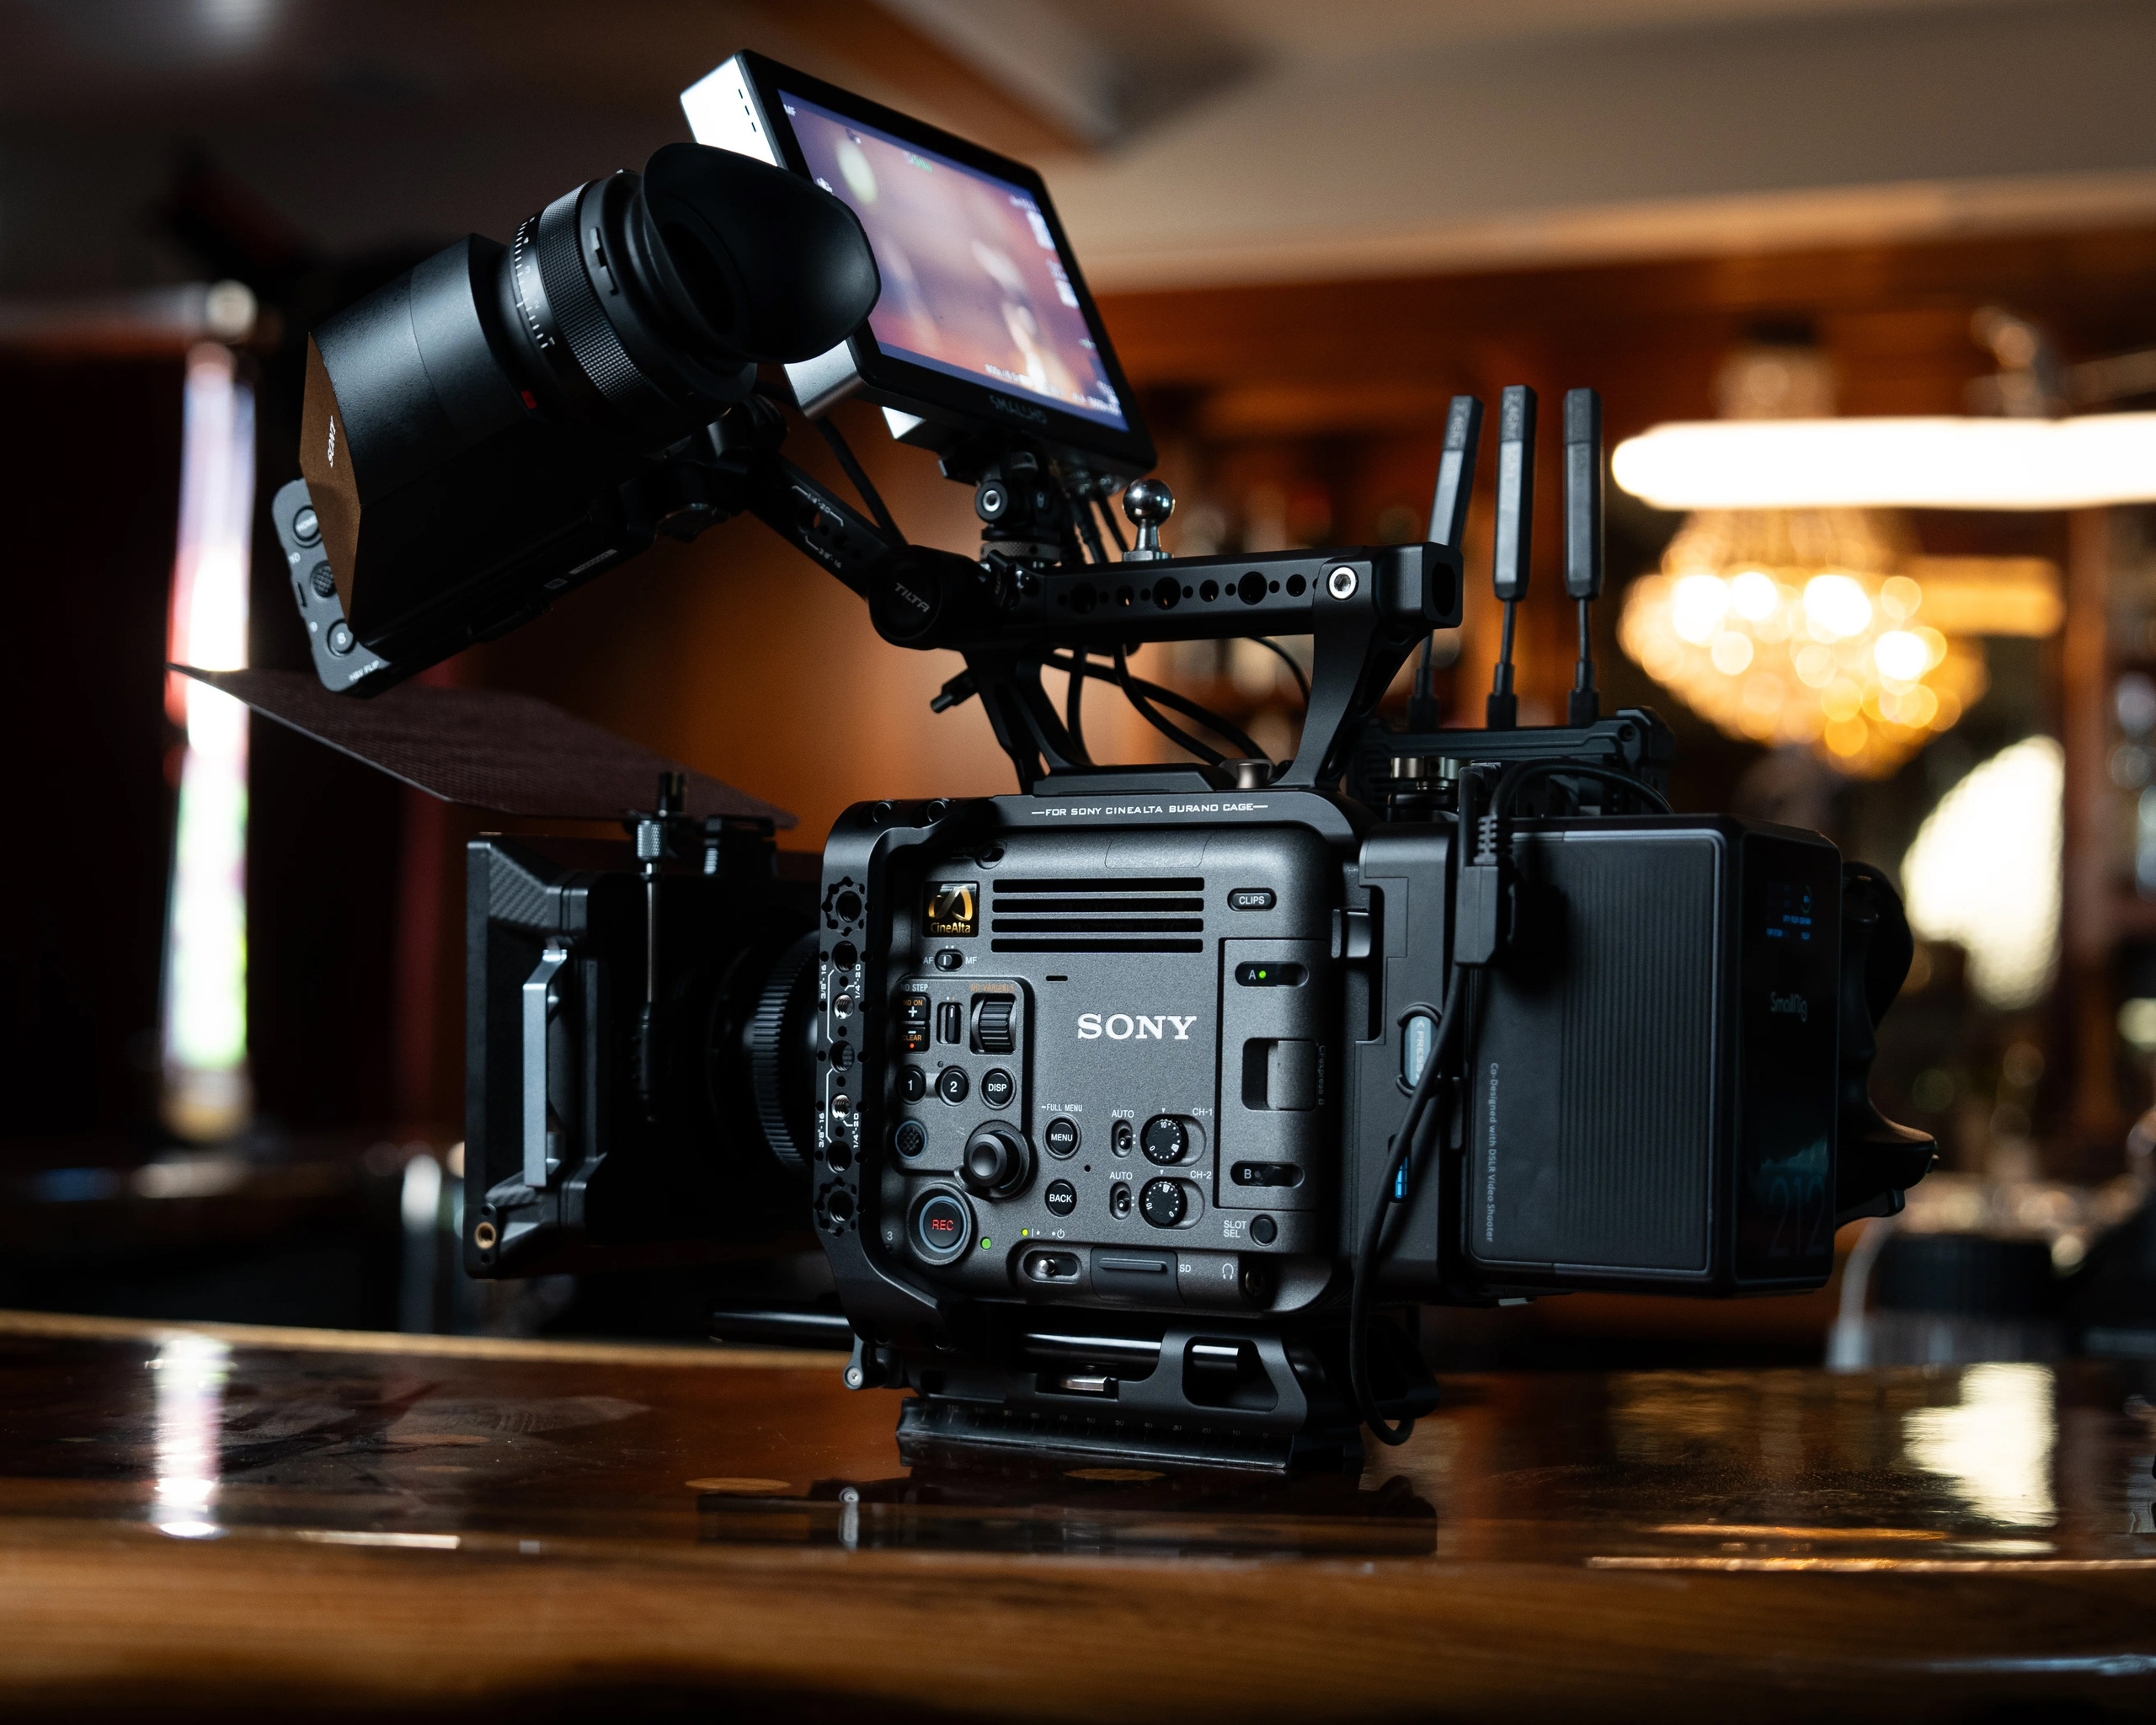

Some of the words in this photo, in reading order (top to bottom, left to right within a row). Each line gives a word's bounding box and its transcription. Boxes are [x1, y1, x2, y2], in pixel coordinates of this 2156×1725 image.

[526, 265, 531, 274] 3
[534, 300, 541, 309] 2
[894, 582, 931, 612] TILTA
[1045, 808, 1067, 816] FOR
[1070, 807, 1102, 815] SONY
[1169, 804, 1219, 813] BURANO
[1223, 803, 1254, 811] CAGE
[1239, 895, 1265, 905] CLIPS
[931, 921, 971, 934] CineAlta
[923, 956, 934, 964] AF
[965, 956, 978, 964] MF
[1247, 969, 1257, 980] A
[911, 984, 929, 992] STEP
[1077, 1013, 1198, 1040] SONY
[908, 1079, 913, 1091] 1
[950, 1081, 958, 1092] 2
[988, 1083, 1007, 1092] DISP
[1111, 1109, 1134, 1118] AUTO
[1192, 1108, 1213, 1116] CH-1
[1051, 1133, 1073, 1141] MENU
[1488, 1148, 1497, 1172] DSLR
[1109, 1171, 1133, 1180] AUTO
[1190, 1170, 1212, 1179] CH-2
[1244, 1169, 1251, 1179] B
[1487, 1173, 1496, 1202] Video
[1049, 1194, 1072, 1203] BACK
[1146, 1202, 1153, 1210] 10
[931, 1219, 954, 1231] REC
[1224, 1220, 1247, 1229] SLOT
[1486, 1203, 1496, 1242] Shooter
[887, 1231, 893, 1241] 3
[1224, 1229, 1241, 1238] SEL
[1179, 1264, 1192, 1273] SD
